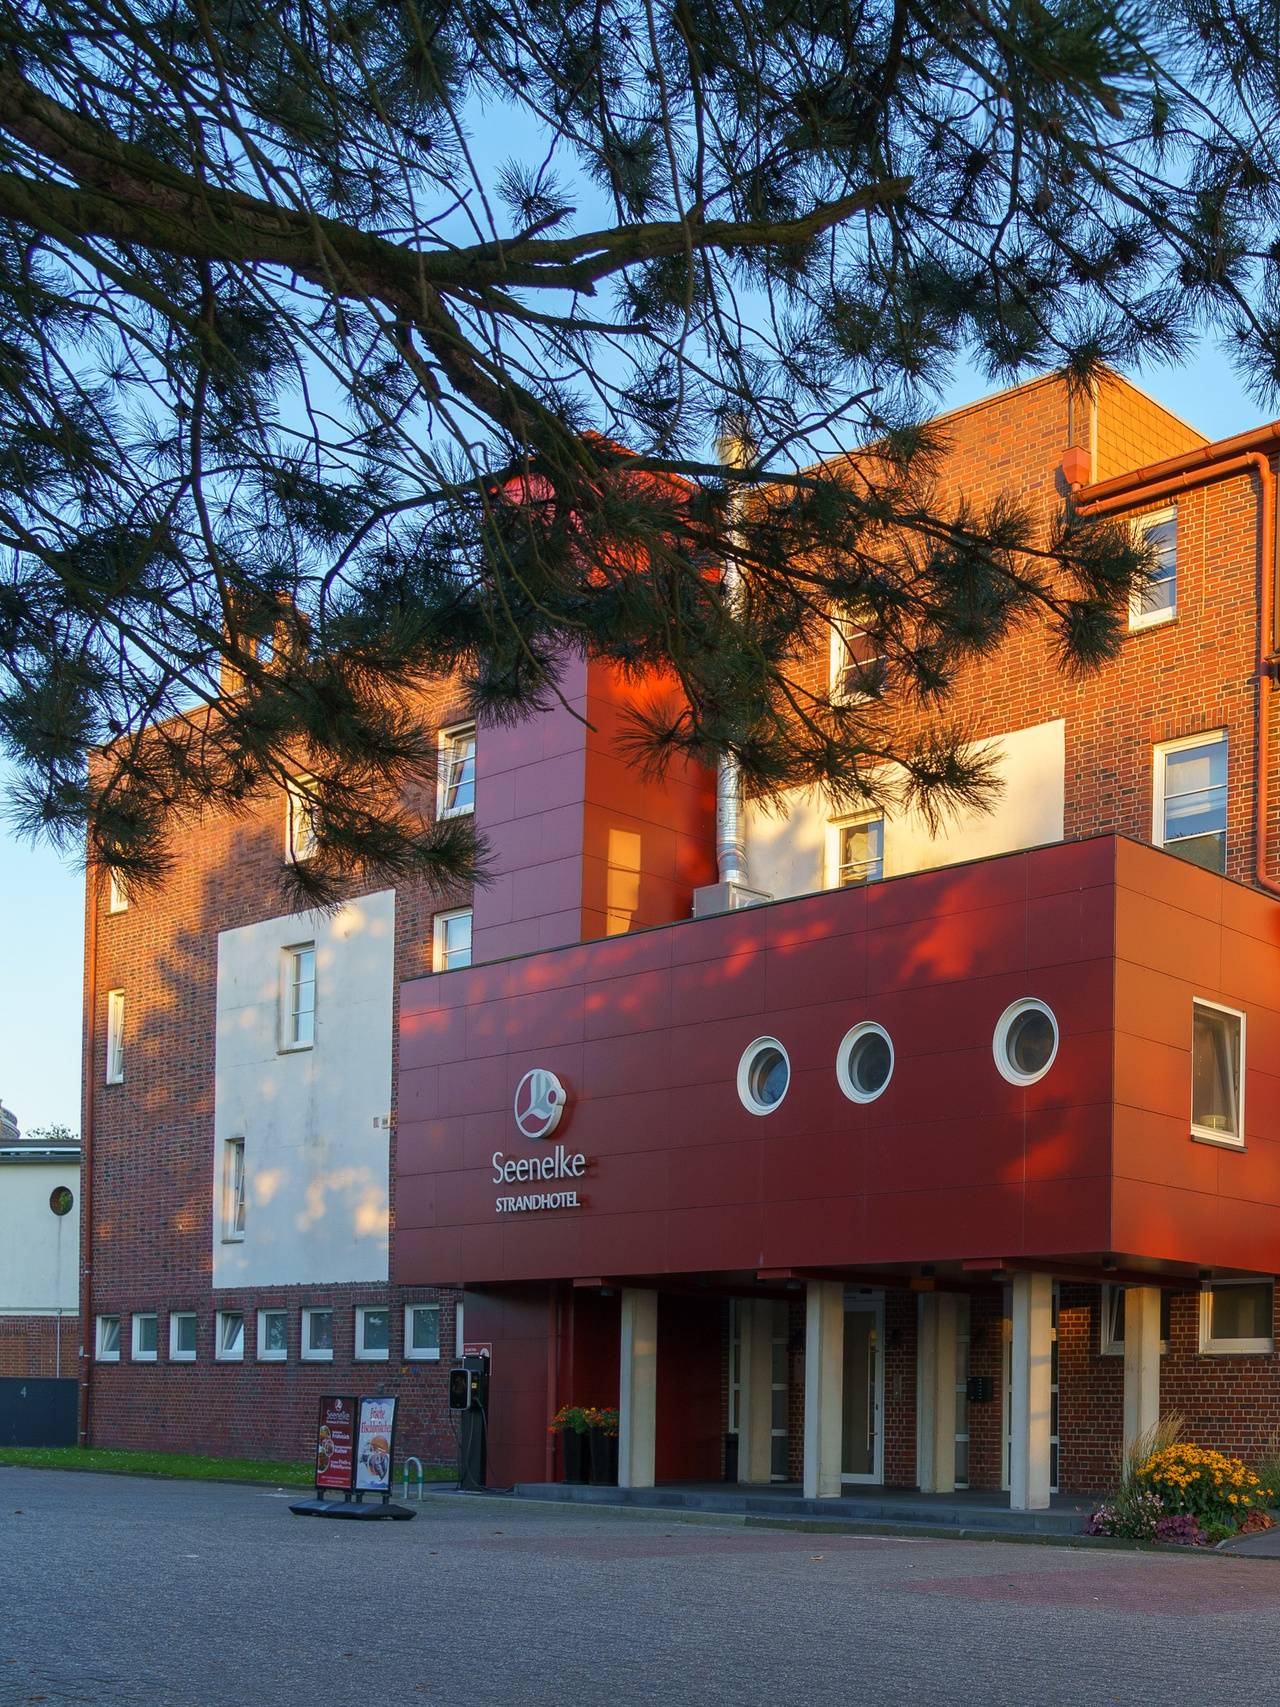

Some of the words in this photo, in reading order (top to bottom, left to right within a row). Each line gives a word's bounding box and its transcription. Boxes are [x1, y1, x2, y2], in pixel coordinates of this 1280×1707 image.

[492, 1145, 586, 1184] Seenelke
[495, 1191, 580, 1213] STRANDHOTEL
[21, 1386, 27, 1398] 4
[326, 1410, 350, 1420] Seenelke
